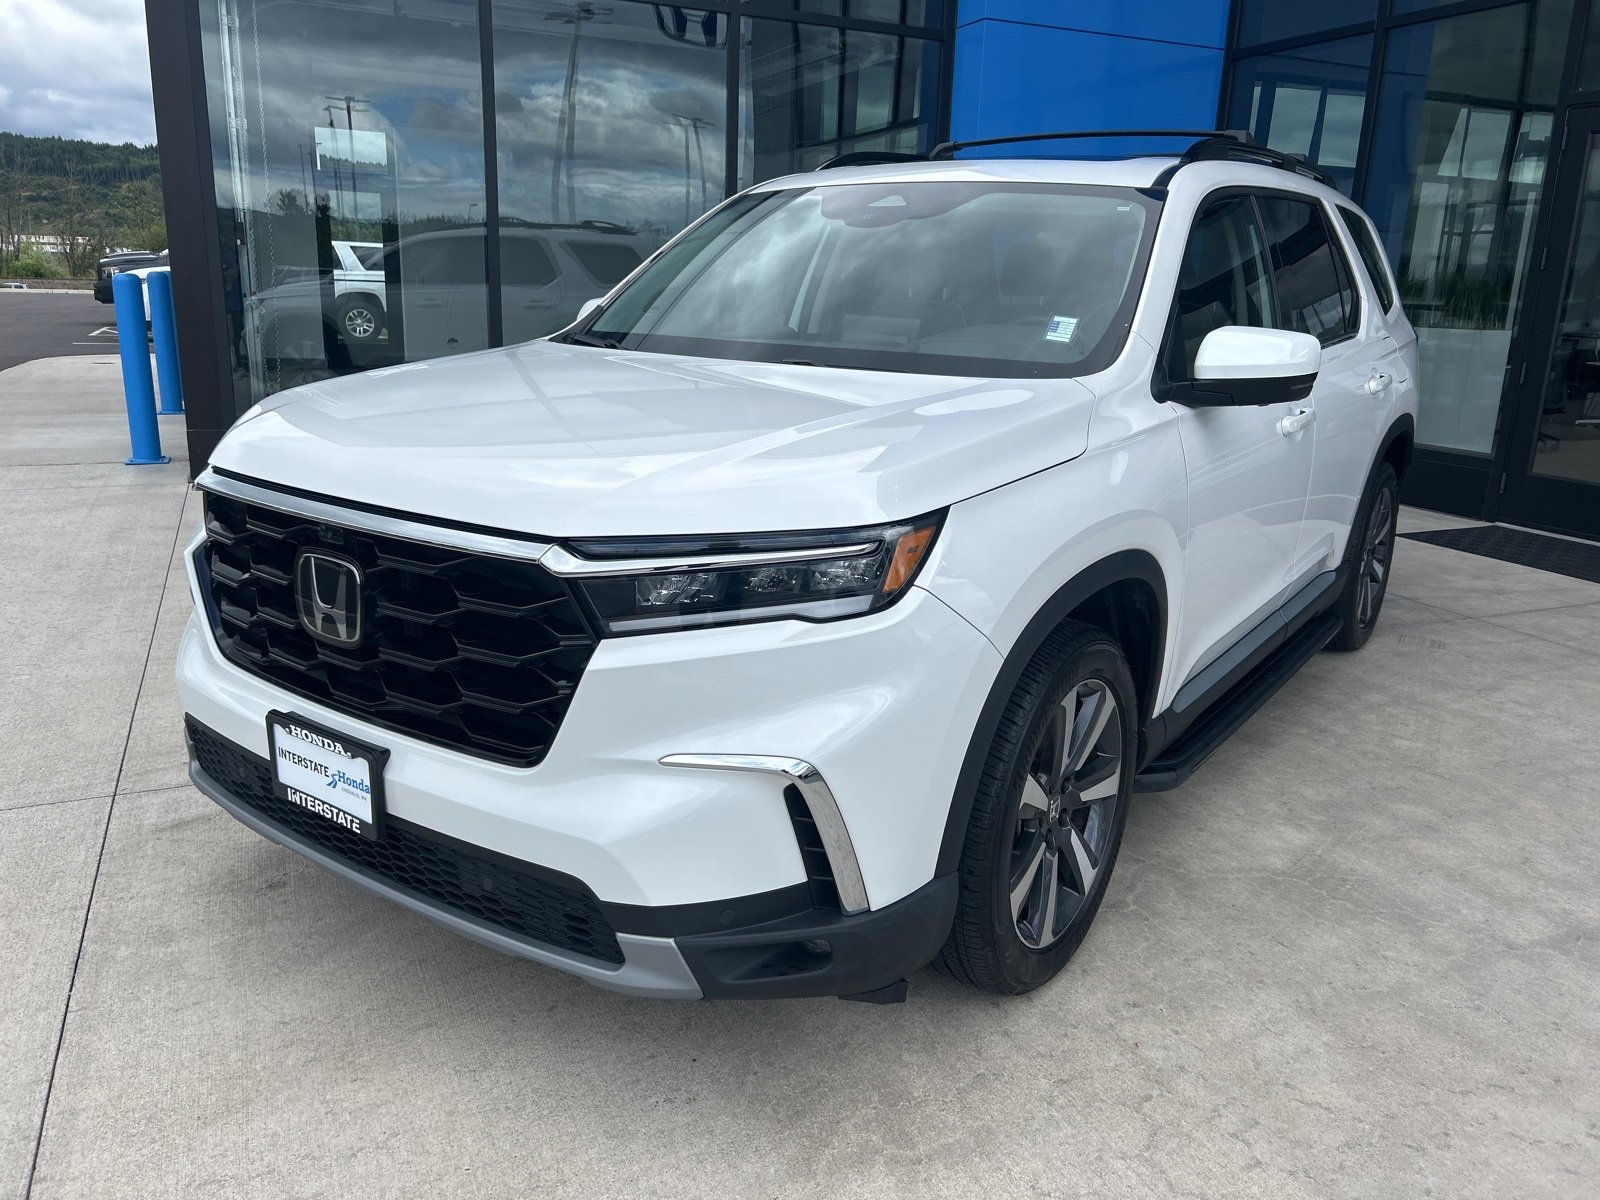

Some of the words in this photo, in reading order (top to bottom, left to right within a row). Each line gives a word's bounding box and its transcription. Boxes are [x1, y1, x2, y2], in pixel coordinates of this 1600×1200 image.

[289, 724, 348, 756] HONDA
[278, 746, 330, 778] INTERSTATE
[337, 770, 371, 795] Honda
[287, 787, 361, 834] INTERSTATE
